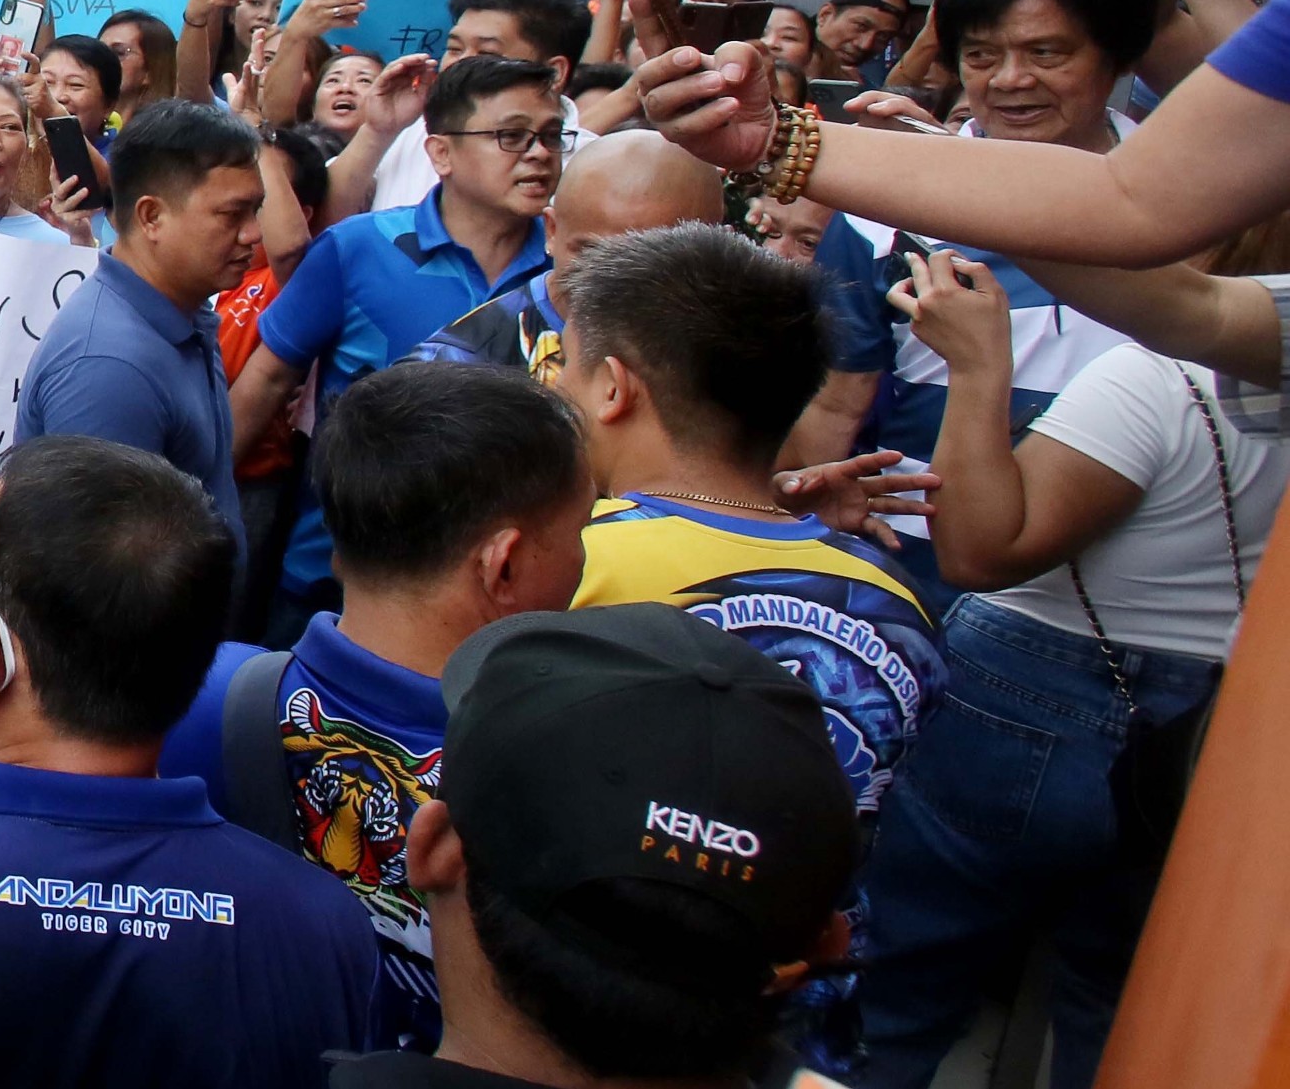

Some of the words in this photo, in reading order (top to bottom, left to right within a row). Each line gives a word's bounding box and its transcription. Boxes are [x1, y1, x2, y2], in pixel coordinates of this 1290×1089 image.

[725, 597, 884, 663] MANDALEÑO
[646, 800, 761, 857] KENZO
[640, 835, 756, 882] PARIS
[41, 913, 108, 934] TIGER
[119, 918, 171, 941] CITY
